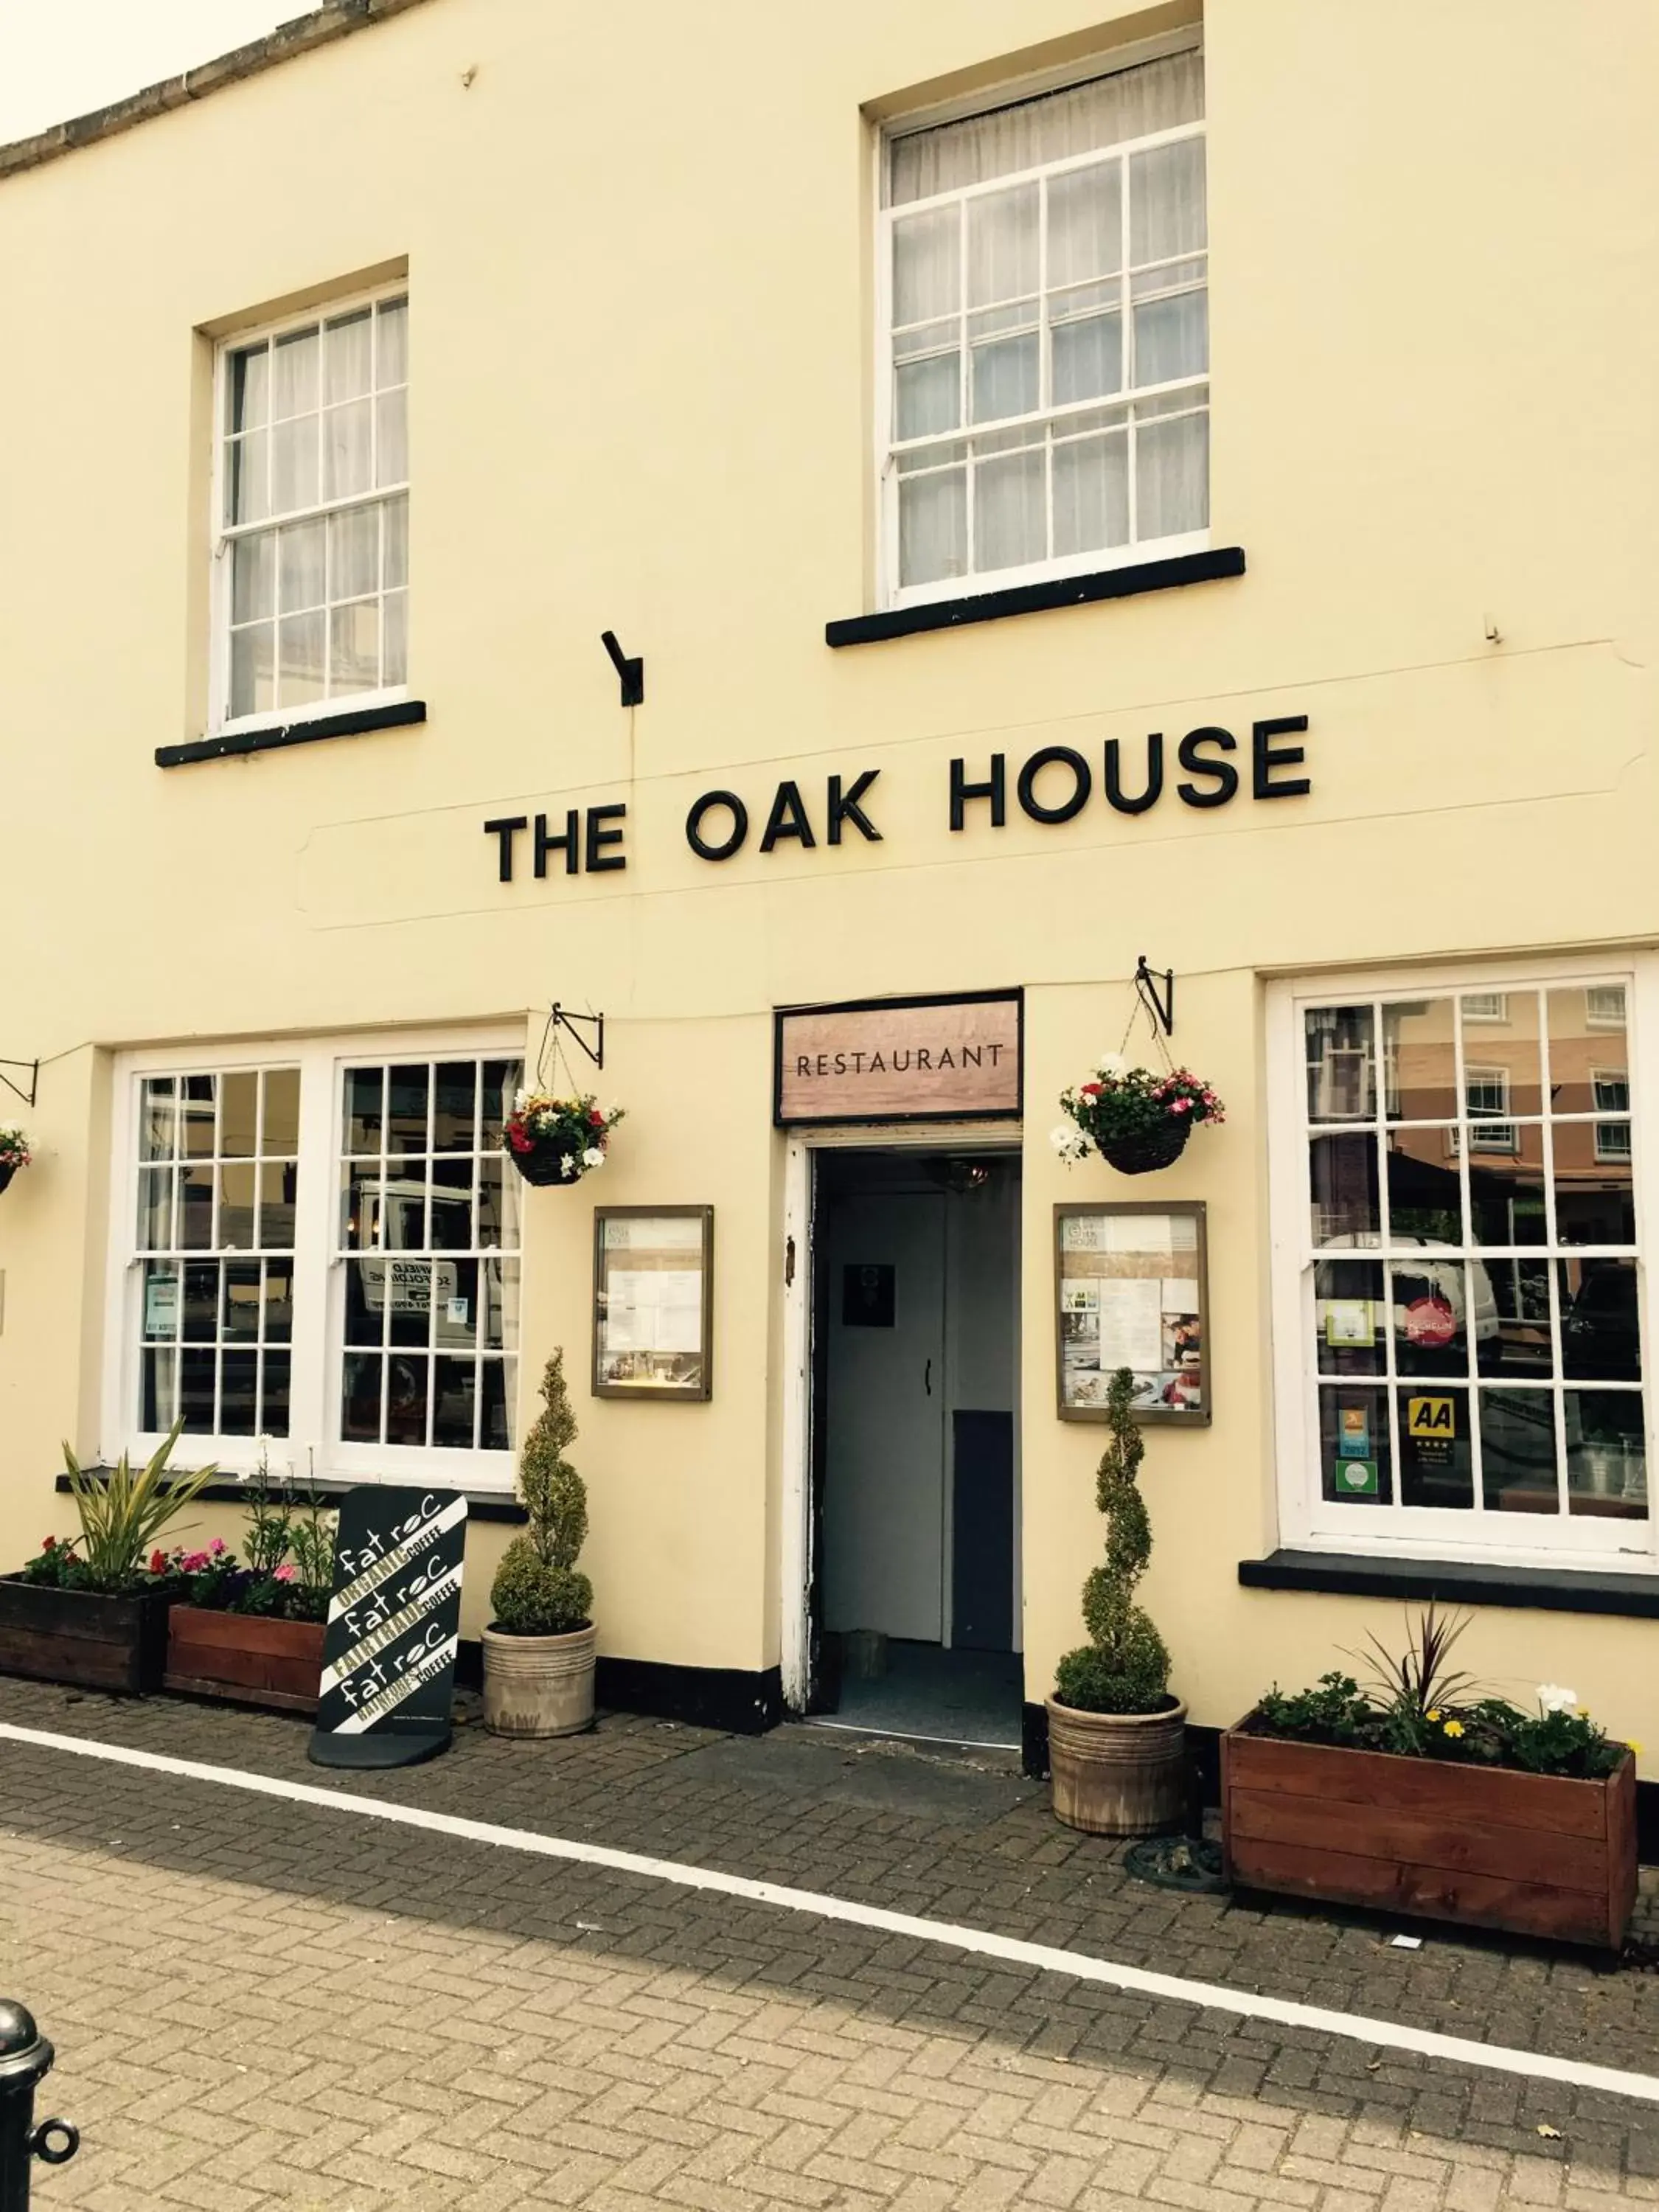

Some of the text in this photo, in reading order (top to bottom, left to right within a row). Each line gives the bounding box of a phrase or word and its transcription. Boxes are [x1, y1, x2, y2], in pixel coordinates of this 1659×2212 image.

[484, 715, 1310, 882] THE OAK HOUSE
[797, 1043, 1004, 1077] RESTAURANT
[1414, 1402, 1450, 1429] AA
[337, 1525, 442, 1608] ORGANIC COFFEE
[338, 1528, 384, 1576] fat
[344, 1590, 390, 1638] fat
[422, 1579, 458, 1612] COFFEE
[340, 1658, 386, 1707] fat
[417, 1649, 453, 1683] COFFEE
